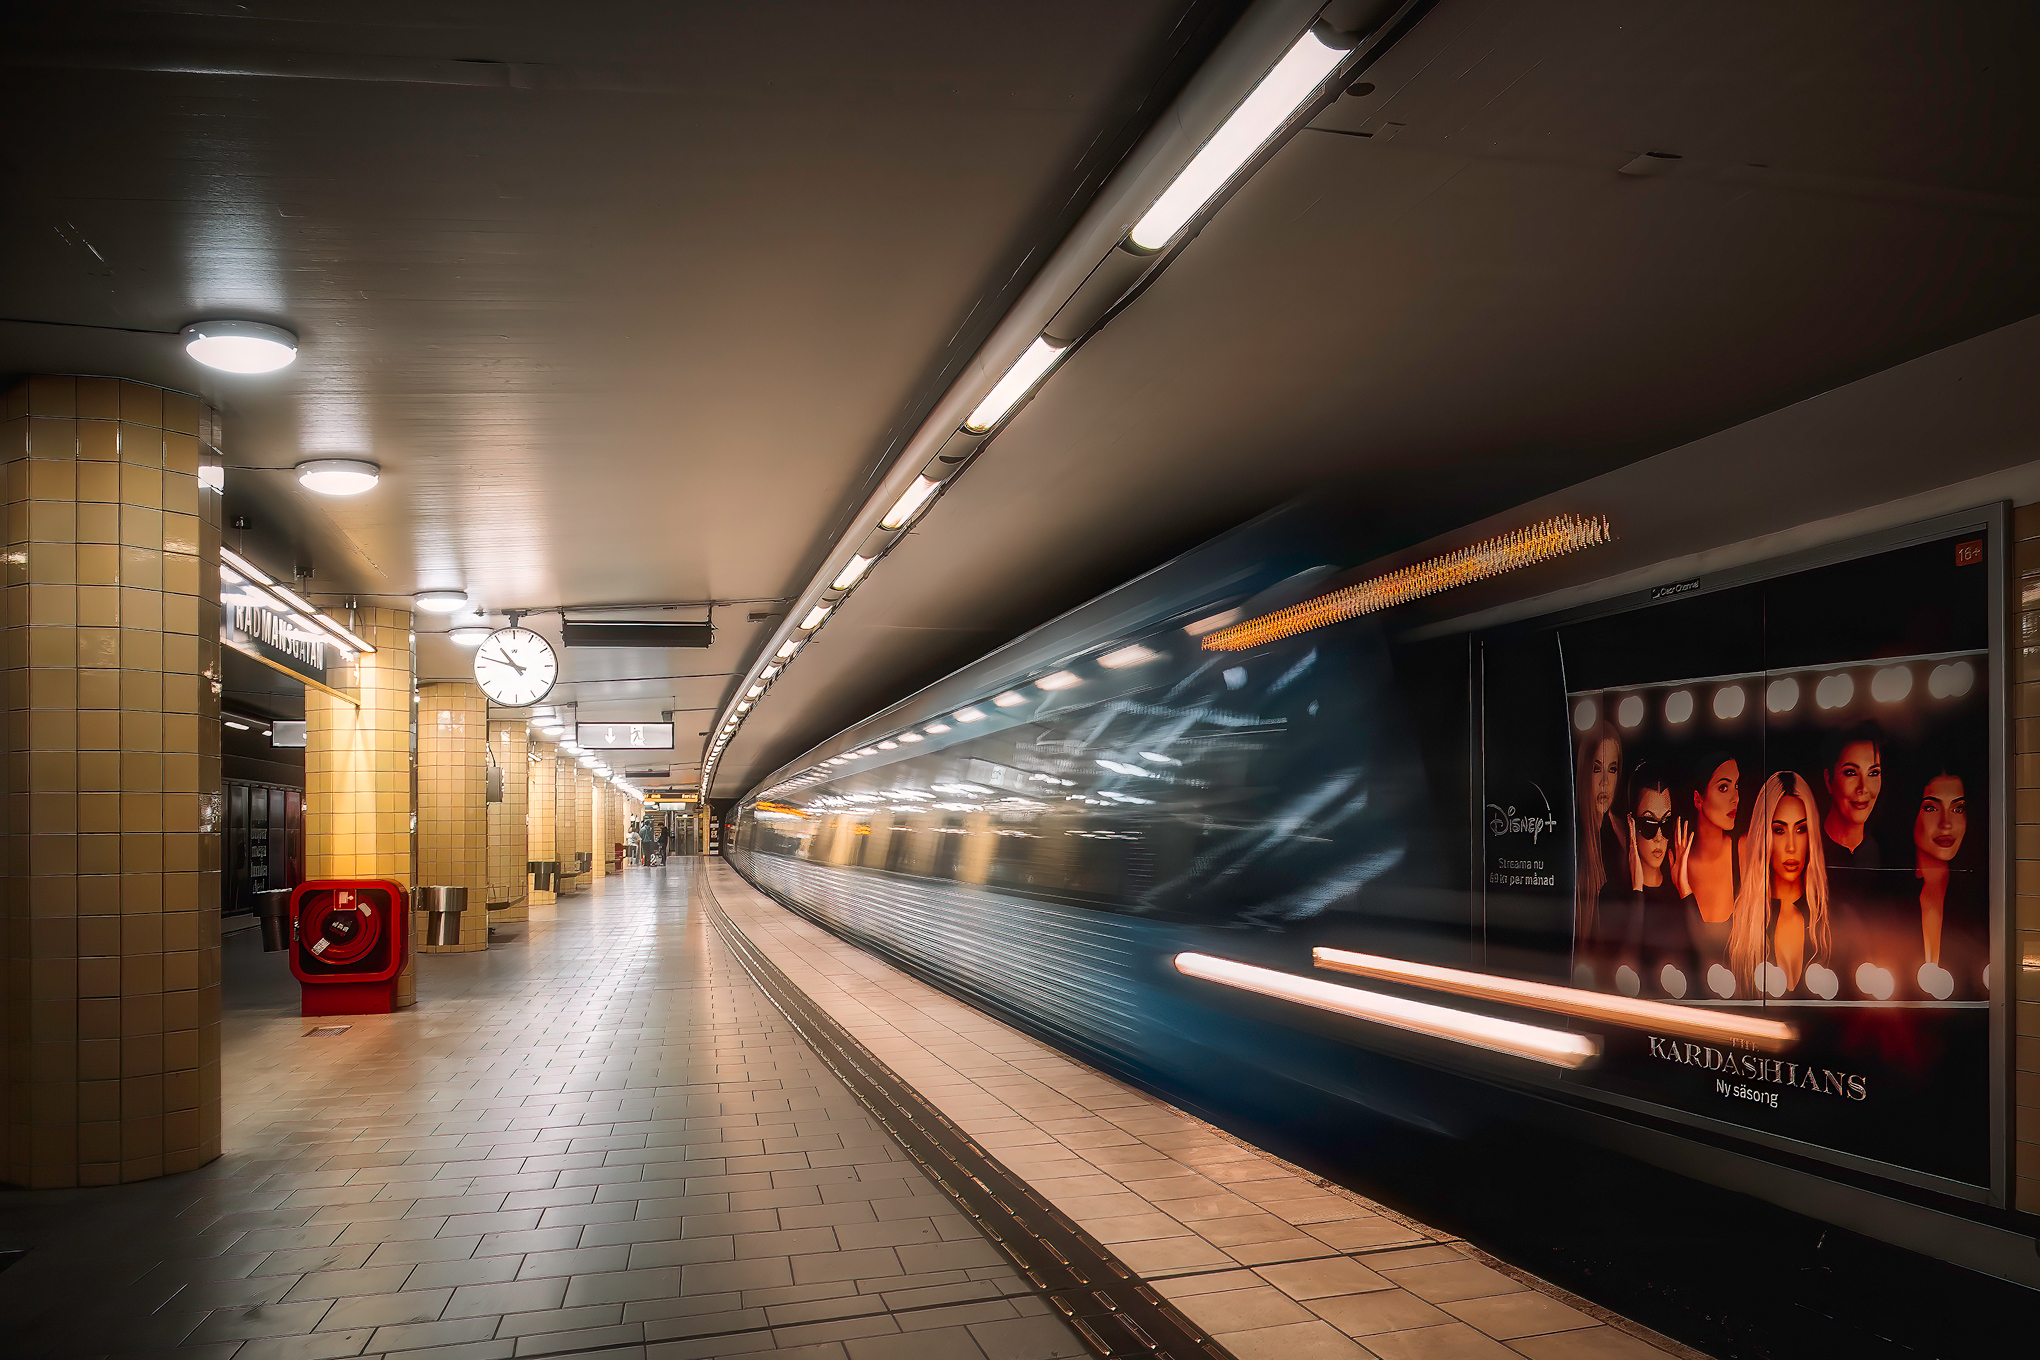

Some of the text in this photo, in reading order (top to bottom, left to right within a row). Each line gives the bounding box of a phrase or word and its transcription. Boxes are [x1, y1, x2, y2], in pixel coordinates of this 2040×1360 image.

[1958, 546, 1981, 562] 16+
[1498, 857, 1544, 870] Streama nu
[1509, 875, 1524, 886] per
[1525, 872, 1555, 886] månad
[1647, 1035, 1867, 1101] KARDASHIANS
[1716, 1078, 1779, 1108] Ny säsong
